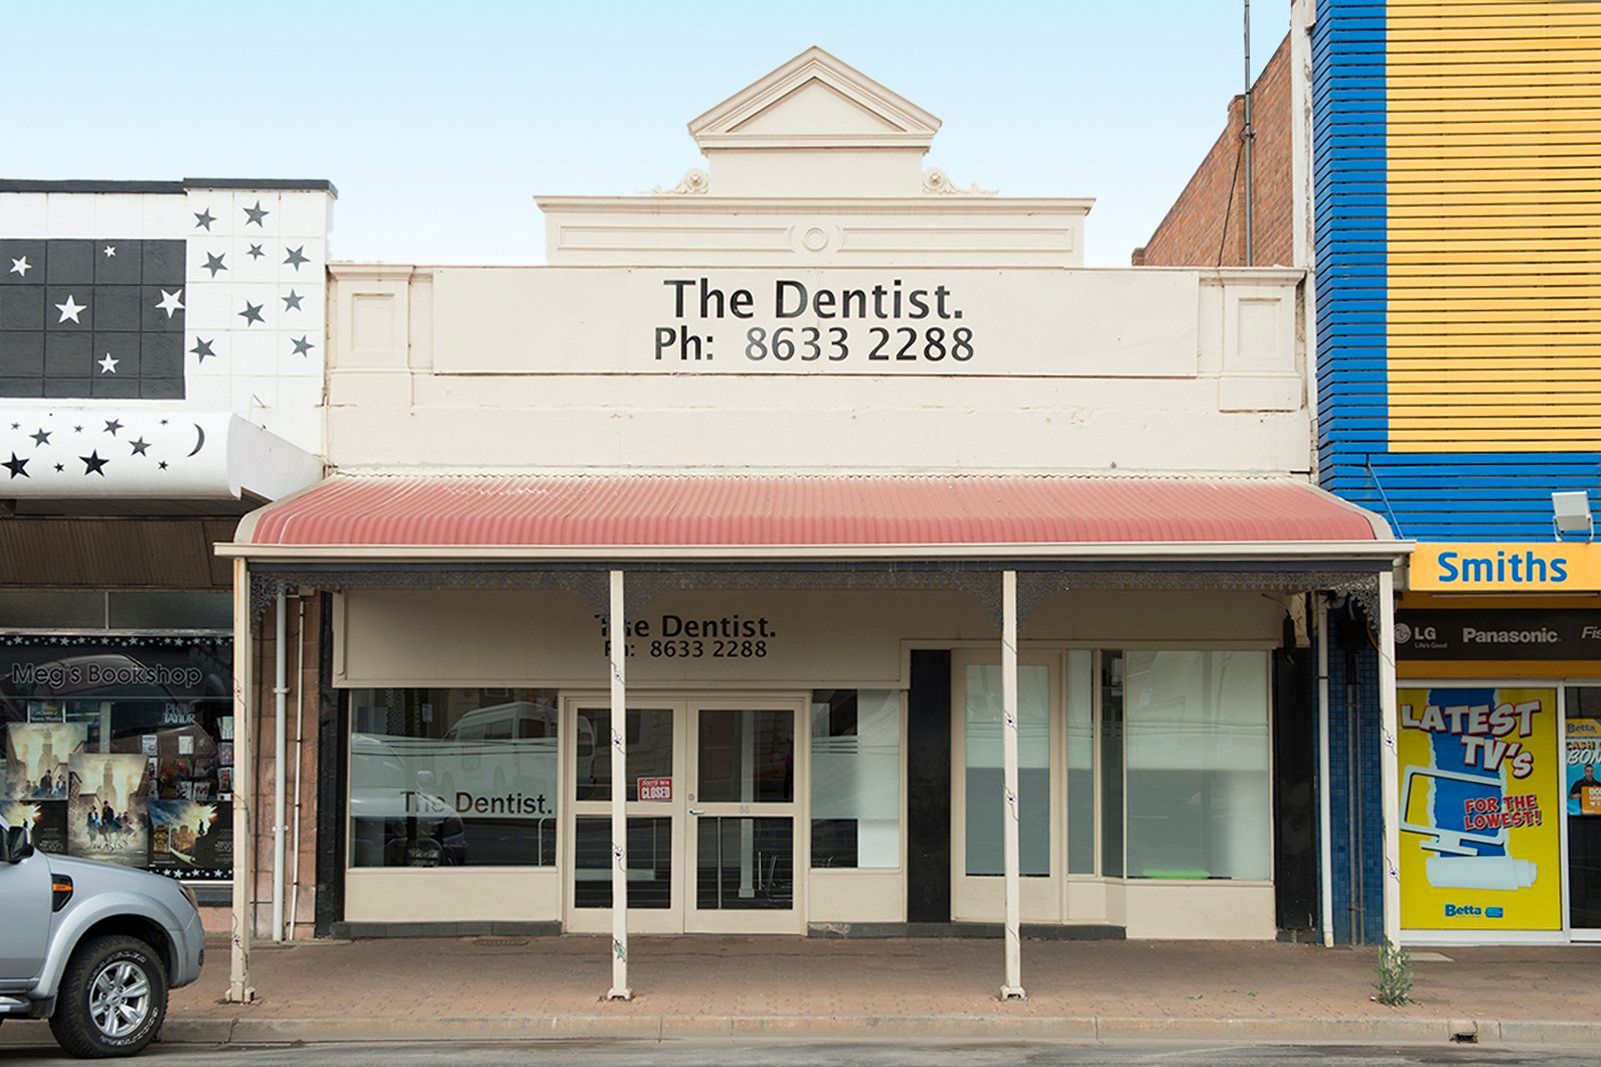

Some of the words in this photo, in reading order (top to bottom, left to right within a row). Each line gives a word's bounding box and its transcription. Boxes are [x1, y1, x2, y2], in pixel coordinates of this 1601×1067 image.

[664, 278, 754, 319] The
[775, 279, 963, 319] Dentist.
[654, 325, 714, 361] Ph:
[744, 327, 849, 361] 8633
[868, 327, 975, 361] 2288
[1438, 550, 1568, 583] Smiths
[661, 614, 776, 638] Dentist.
[1414, 627, 1437, 640] LG
[1462, 628, 1559, 643] Panasonic
[650, 641, 704, 657] 8633
[713, 641, 767, 657] 2288
[12, 662, 82, 689] Meg's
[88, 664, 203, 688] Bookshop
[1401, 700, 1542, 738] LATEST
[455, 791, 552, 814] Dentist.
[641, 786, 671, 799] CLOSED
[1464, 797, 1499, 813] FOR
[1502, 794, 1538, 810] THE
[1463, 809, 1543, 831] LOWEST!
[1445, 904, 1482, 917] Betta
